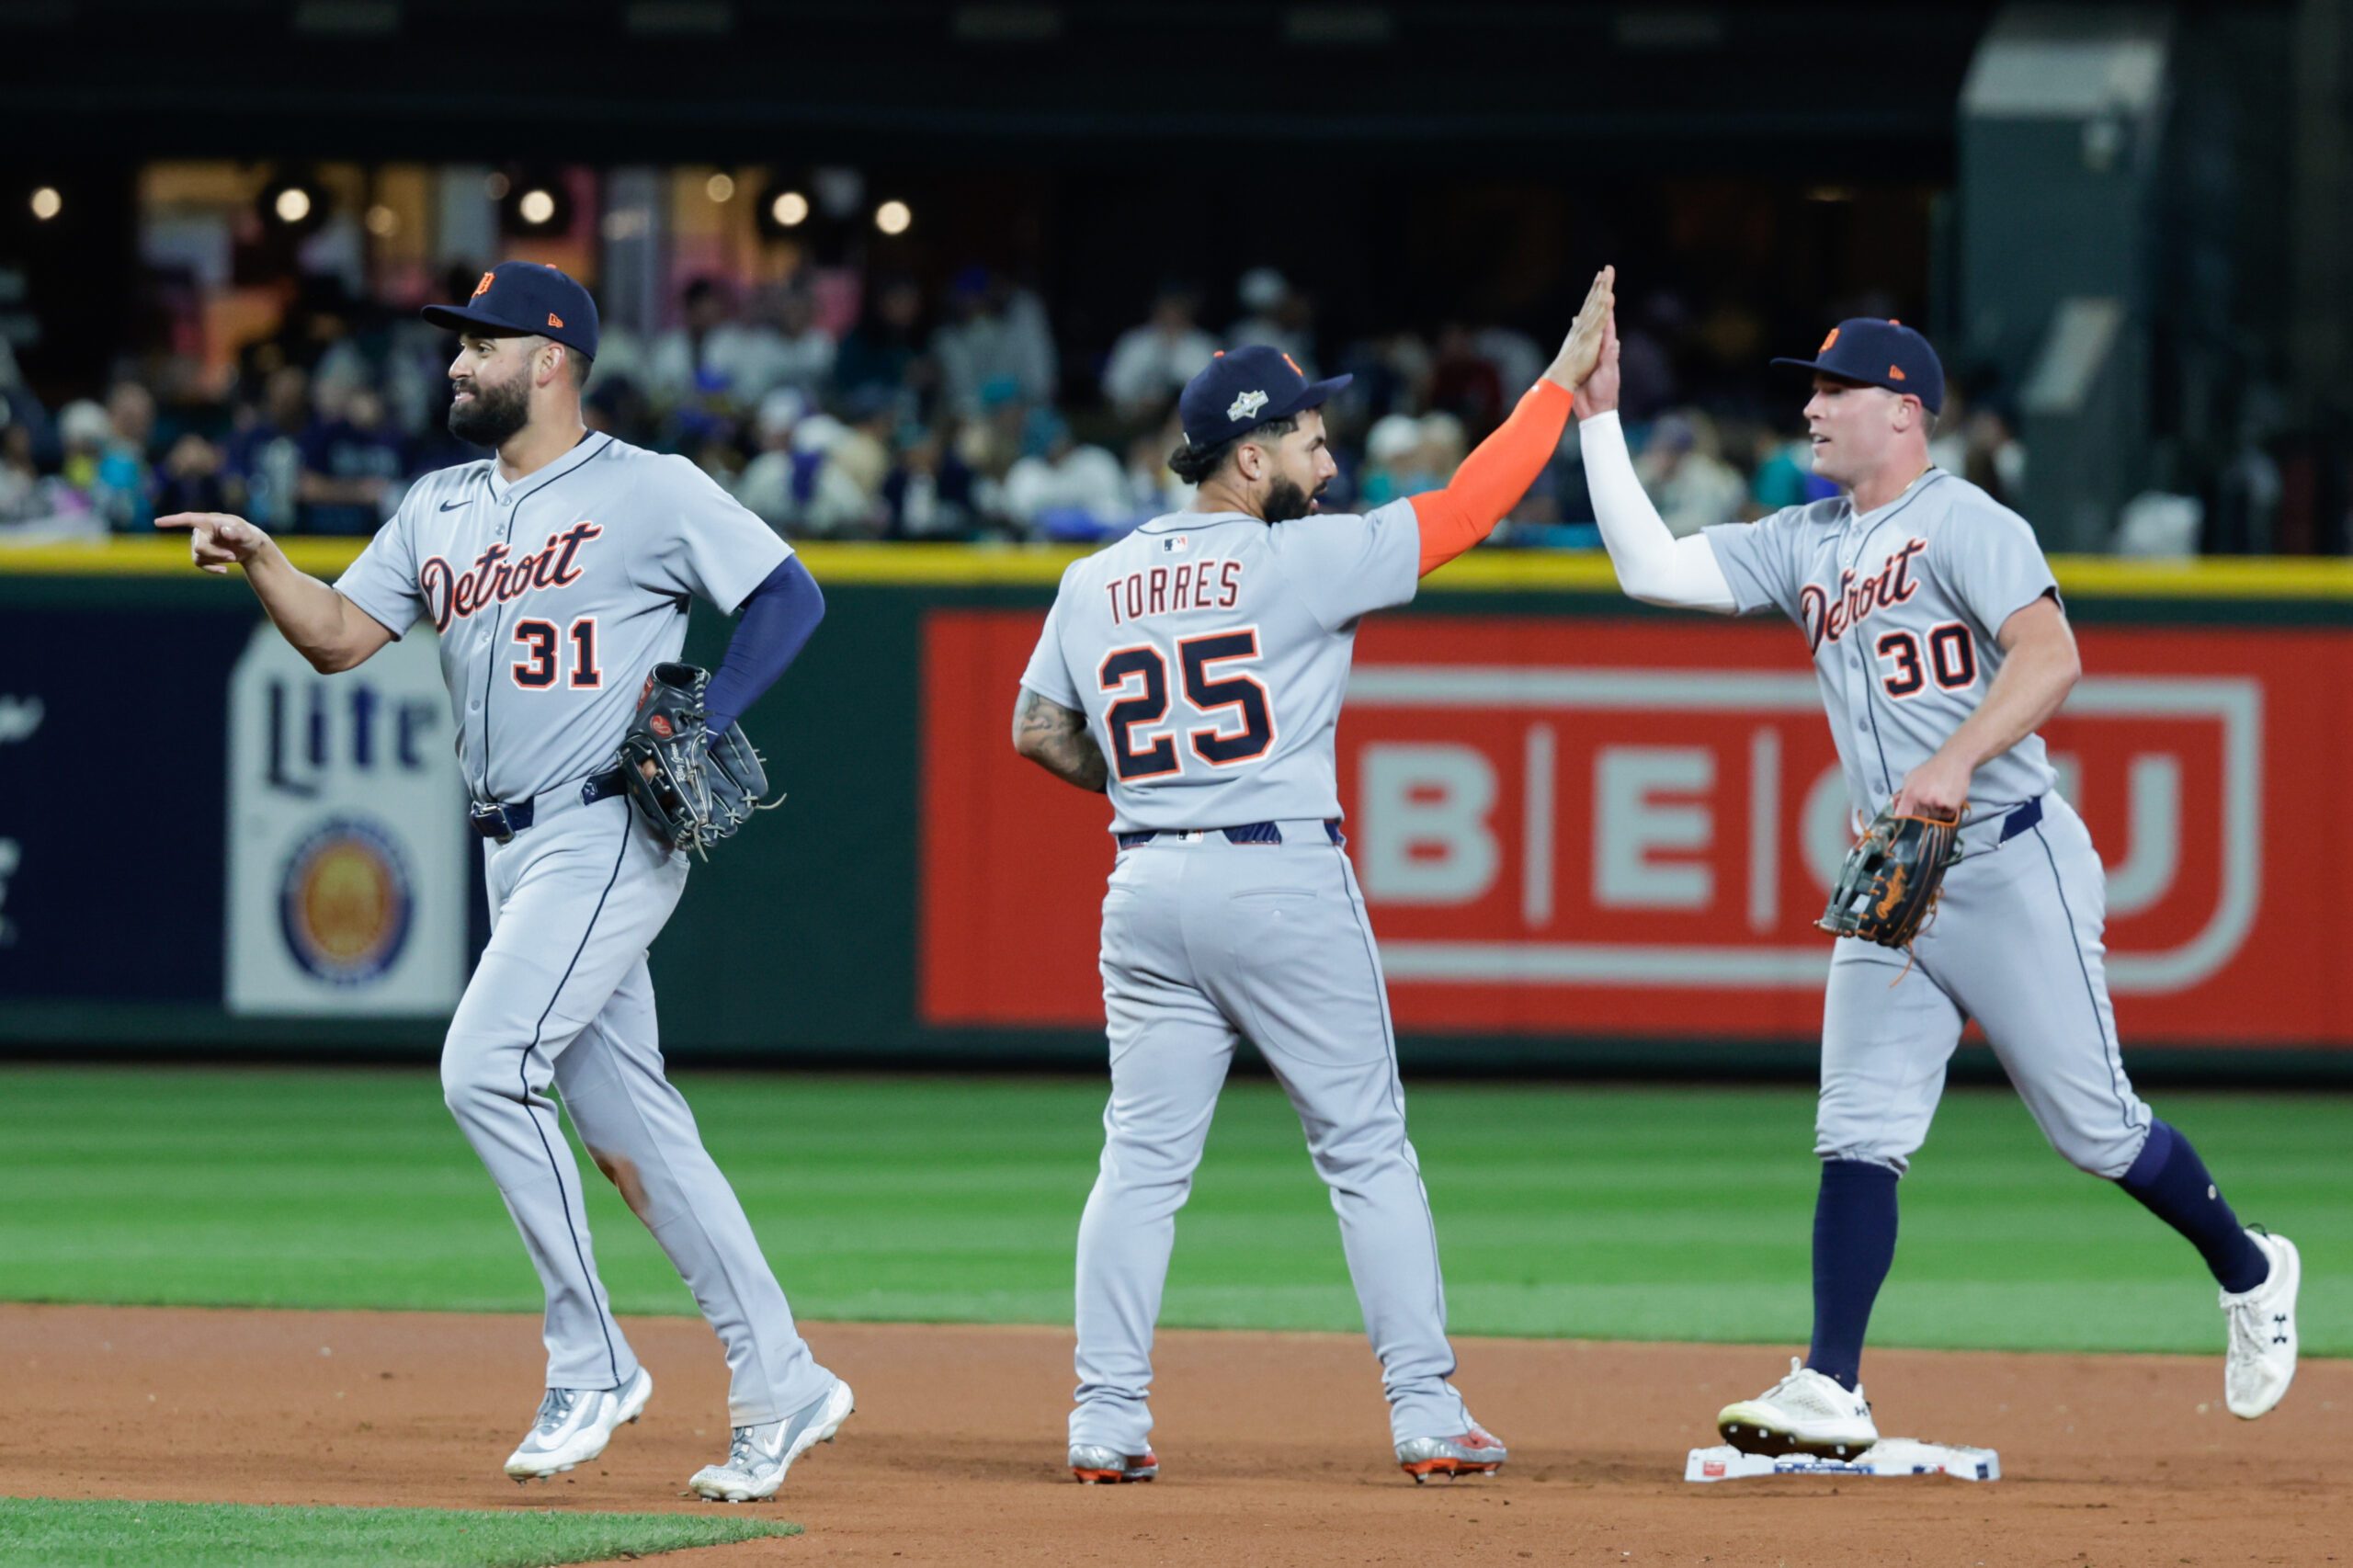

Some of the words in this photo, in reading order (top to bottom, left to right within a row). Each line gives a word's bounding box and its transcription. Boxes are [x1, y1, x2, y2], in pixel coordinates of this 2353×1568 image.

[420, 520, 604, 635] Detroit
[1106, 560, 1242, 625] TORRES
[1800, 537, 1927, 657] Detroit
[512, 619, 603, 690] 31
[1098, 627, 1278, 784] 25
[1877, 621, 1977, 699] 30
[267, 676, 439, 798] Lite
